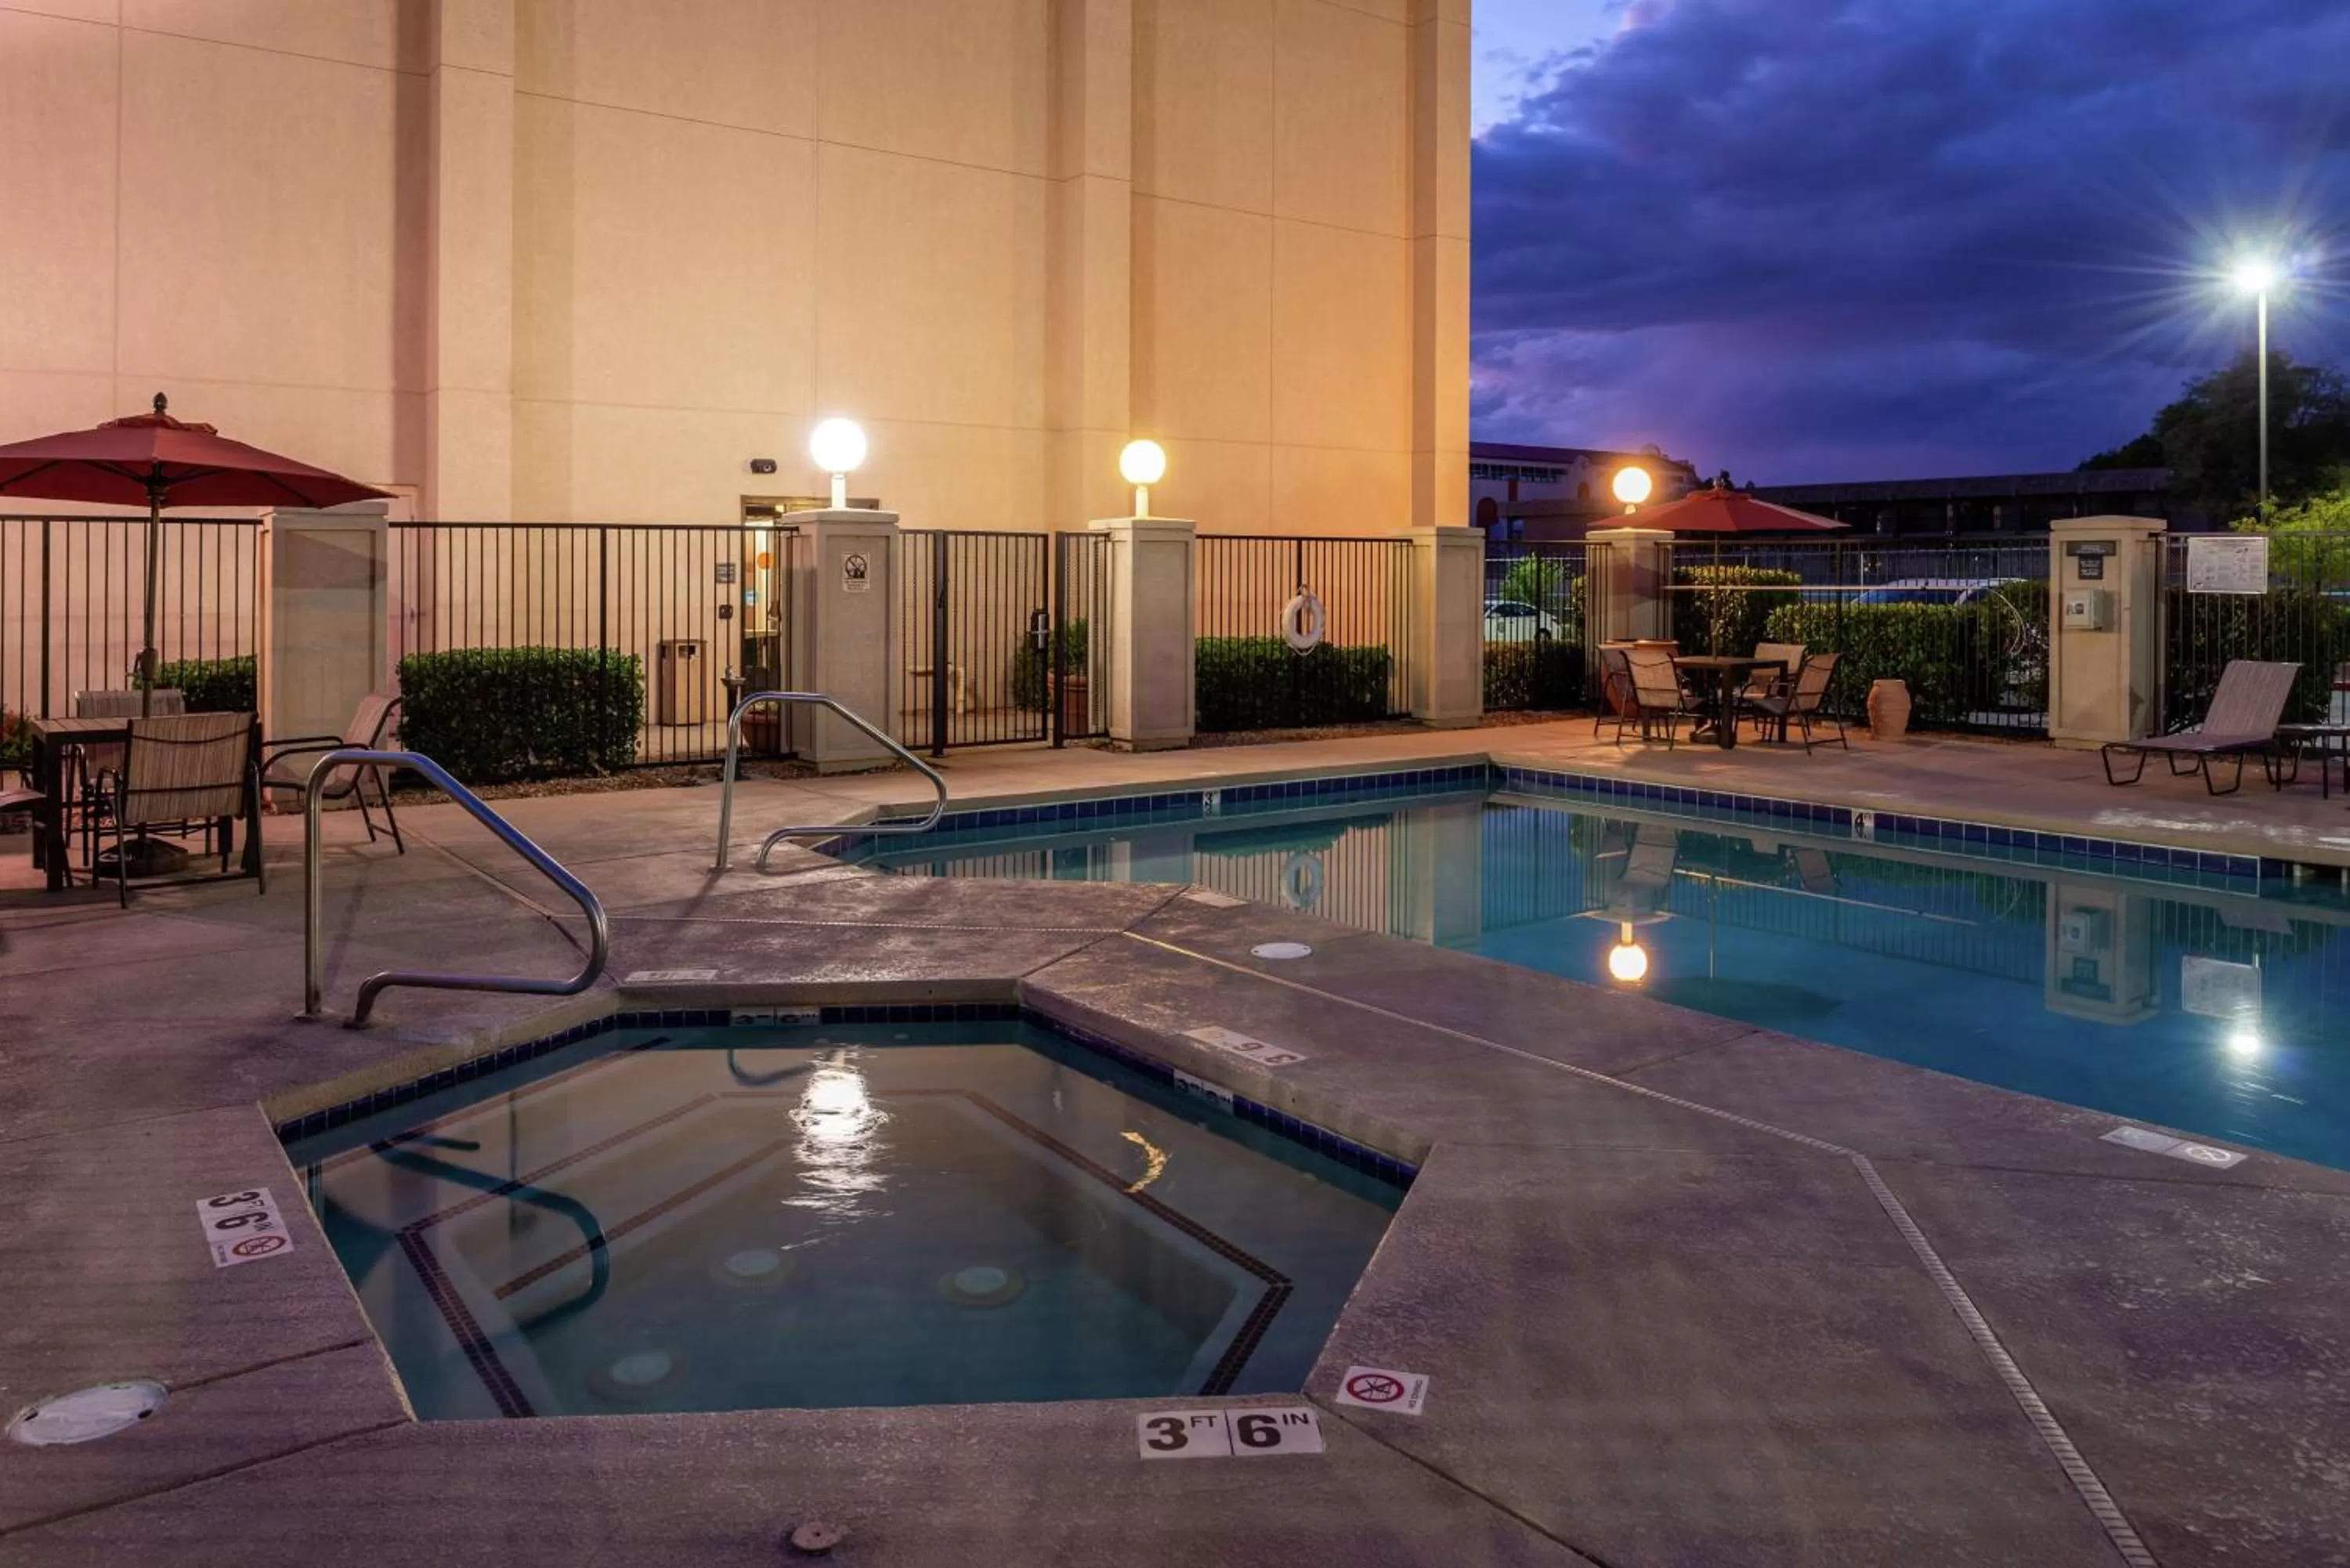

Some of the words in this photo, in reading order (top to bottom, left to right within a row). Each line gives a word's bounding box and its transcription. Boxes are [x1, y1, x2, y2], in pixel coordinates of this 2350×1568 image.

[208, 1191, 261, 1208] 3
[215, 1212, 269, 1230] 6
[1146, 1416, 1189, 1451] 3
[1190, 1415, 1218, 1429] FT
[1235, 1414, 1282, 1448] 6
[1282, 1412, 1310, 1427] IN
